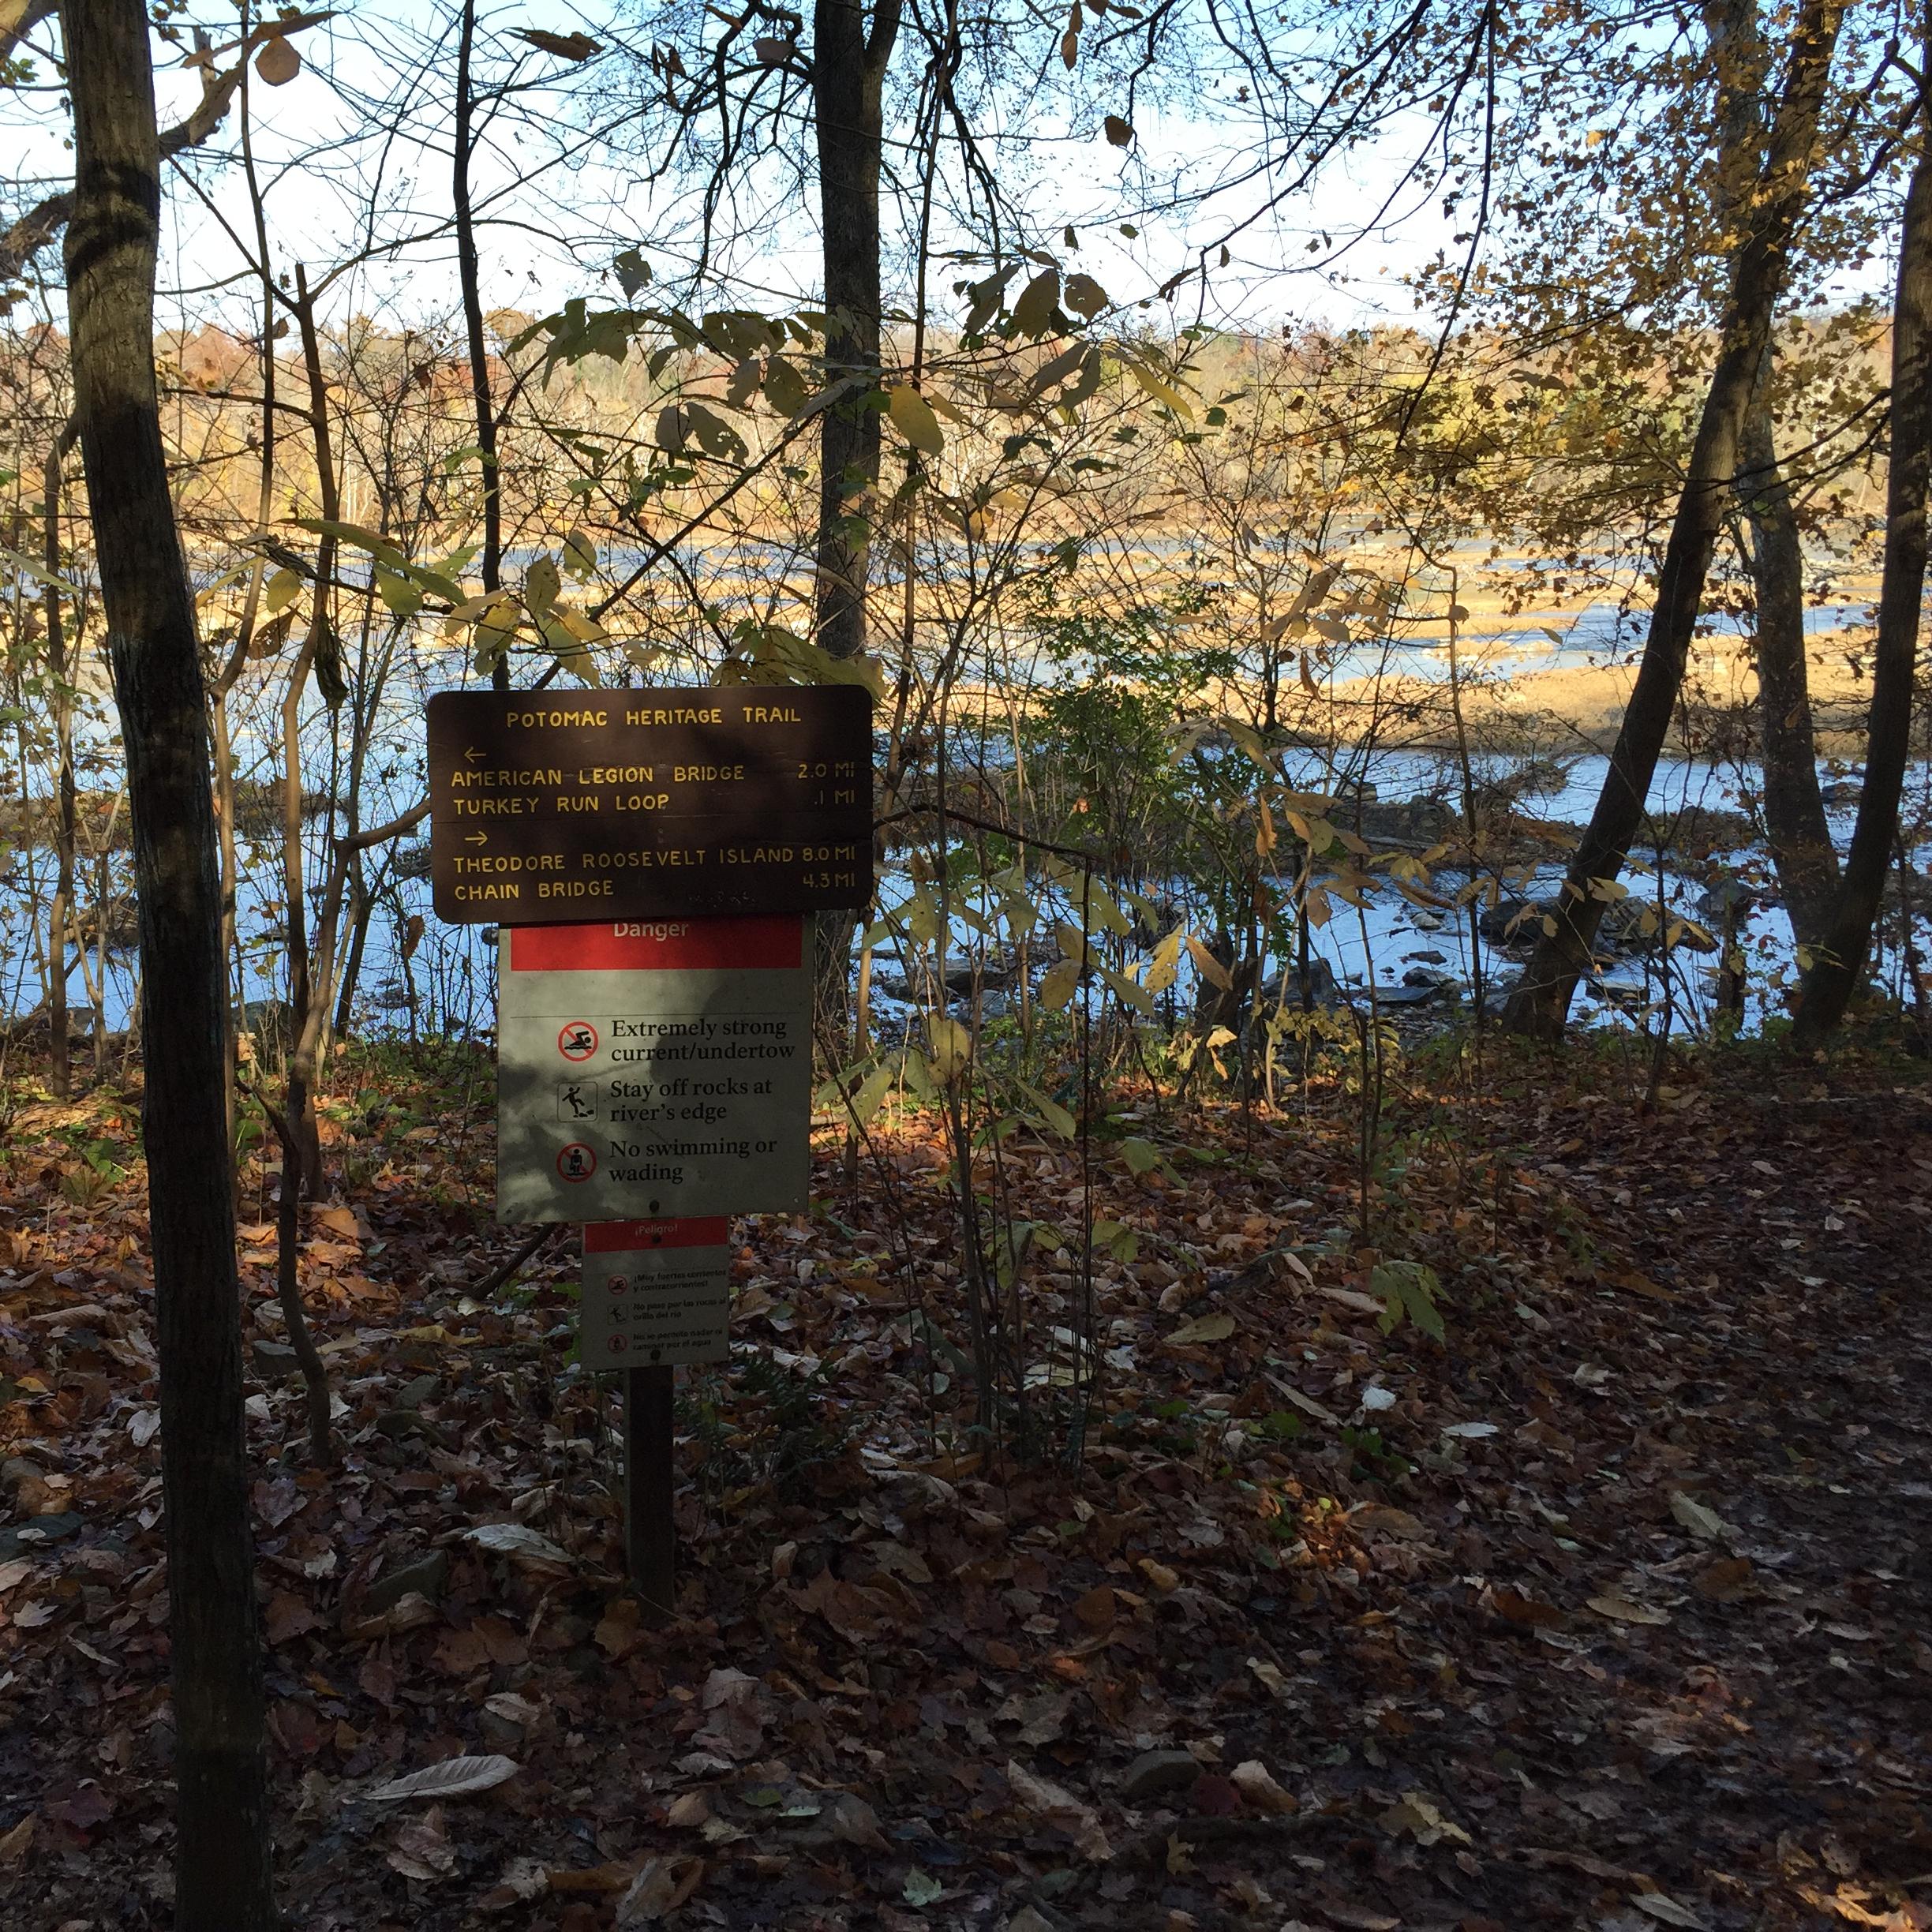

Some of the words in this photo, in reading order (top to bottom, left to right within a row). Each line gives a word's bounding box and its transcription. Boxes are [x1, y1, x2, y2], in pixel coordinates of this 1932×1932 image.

[507, 710, 608, 728] POTOMAC
[626, 708, 722, 726] HERITAGE
[742, 706, 802, 724] TRAIL
[451, 769, 563, 788] AMERICAN
[578, 766, 653, 785] LEGION
[673, 765, 745, 782] BRIDGE
[797, 763, 827, 780] 2.0
[835, 762, 855, 777] MI
[453, 797, 540, 815] TURKEY
[557, 795, 600, 812] RUN
[616, 794, 670, 811] LOOP
[834, 789, 856, 804] MI
[453, 855, 566, 874] THEODORE
[582, 850, 707, 869] ROOSEVELT
[719, 848, 794, 864] ISLAND
[834, 845, 856, 861] MI
[454, 884, 520, 900] CHAIN
[538, 880, 615, 898] BRIDGE
[834, 872, 856, 888] MI
[613, 922, 689, 942] Danger
[611, 1020, 718, 1040] Extremely
[722, 1018, 787, 1039] strong
[610, 1043, 796, 1061] current/undertow
[610, 1080, 653, 1102] Stay
[659, 1079, 690, 1097] off
[692, 1078, 749, 1096] rocks
[753, 1079, 772, 1095] at
[610, 1103, 676, 1122] river's
[680, 1103, 728, 1124] edge
[610, 1140, 641, 1159] No
[646, 1136, 750, 1159] swimming
[754, 1137, 777, 1153] or
[608, 1164, 683, 1183] wading
